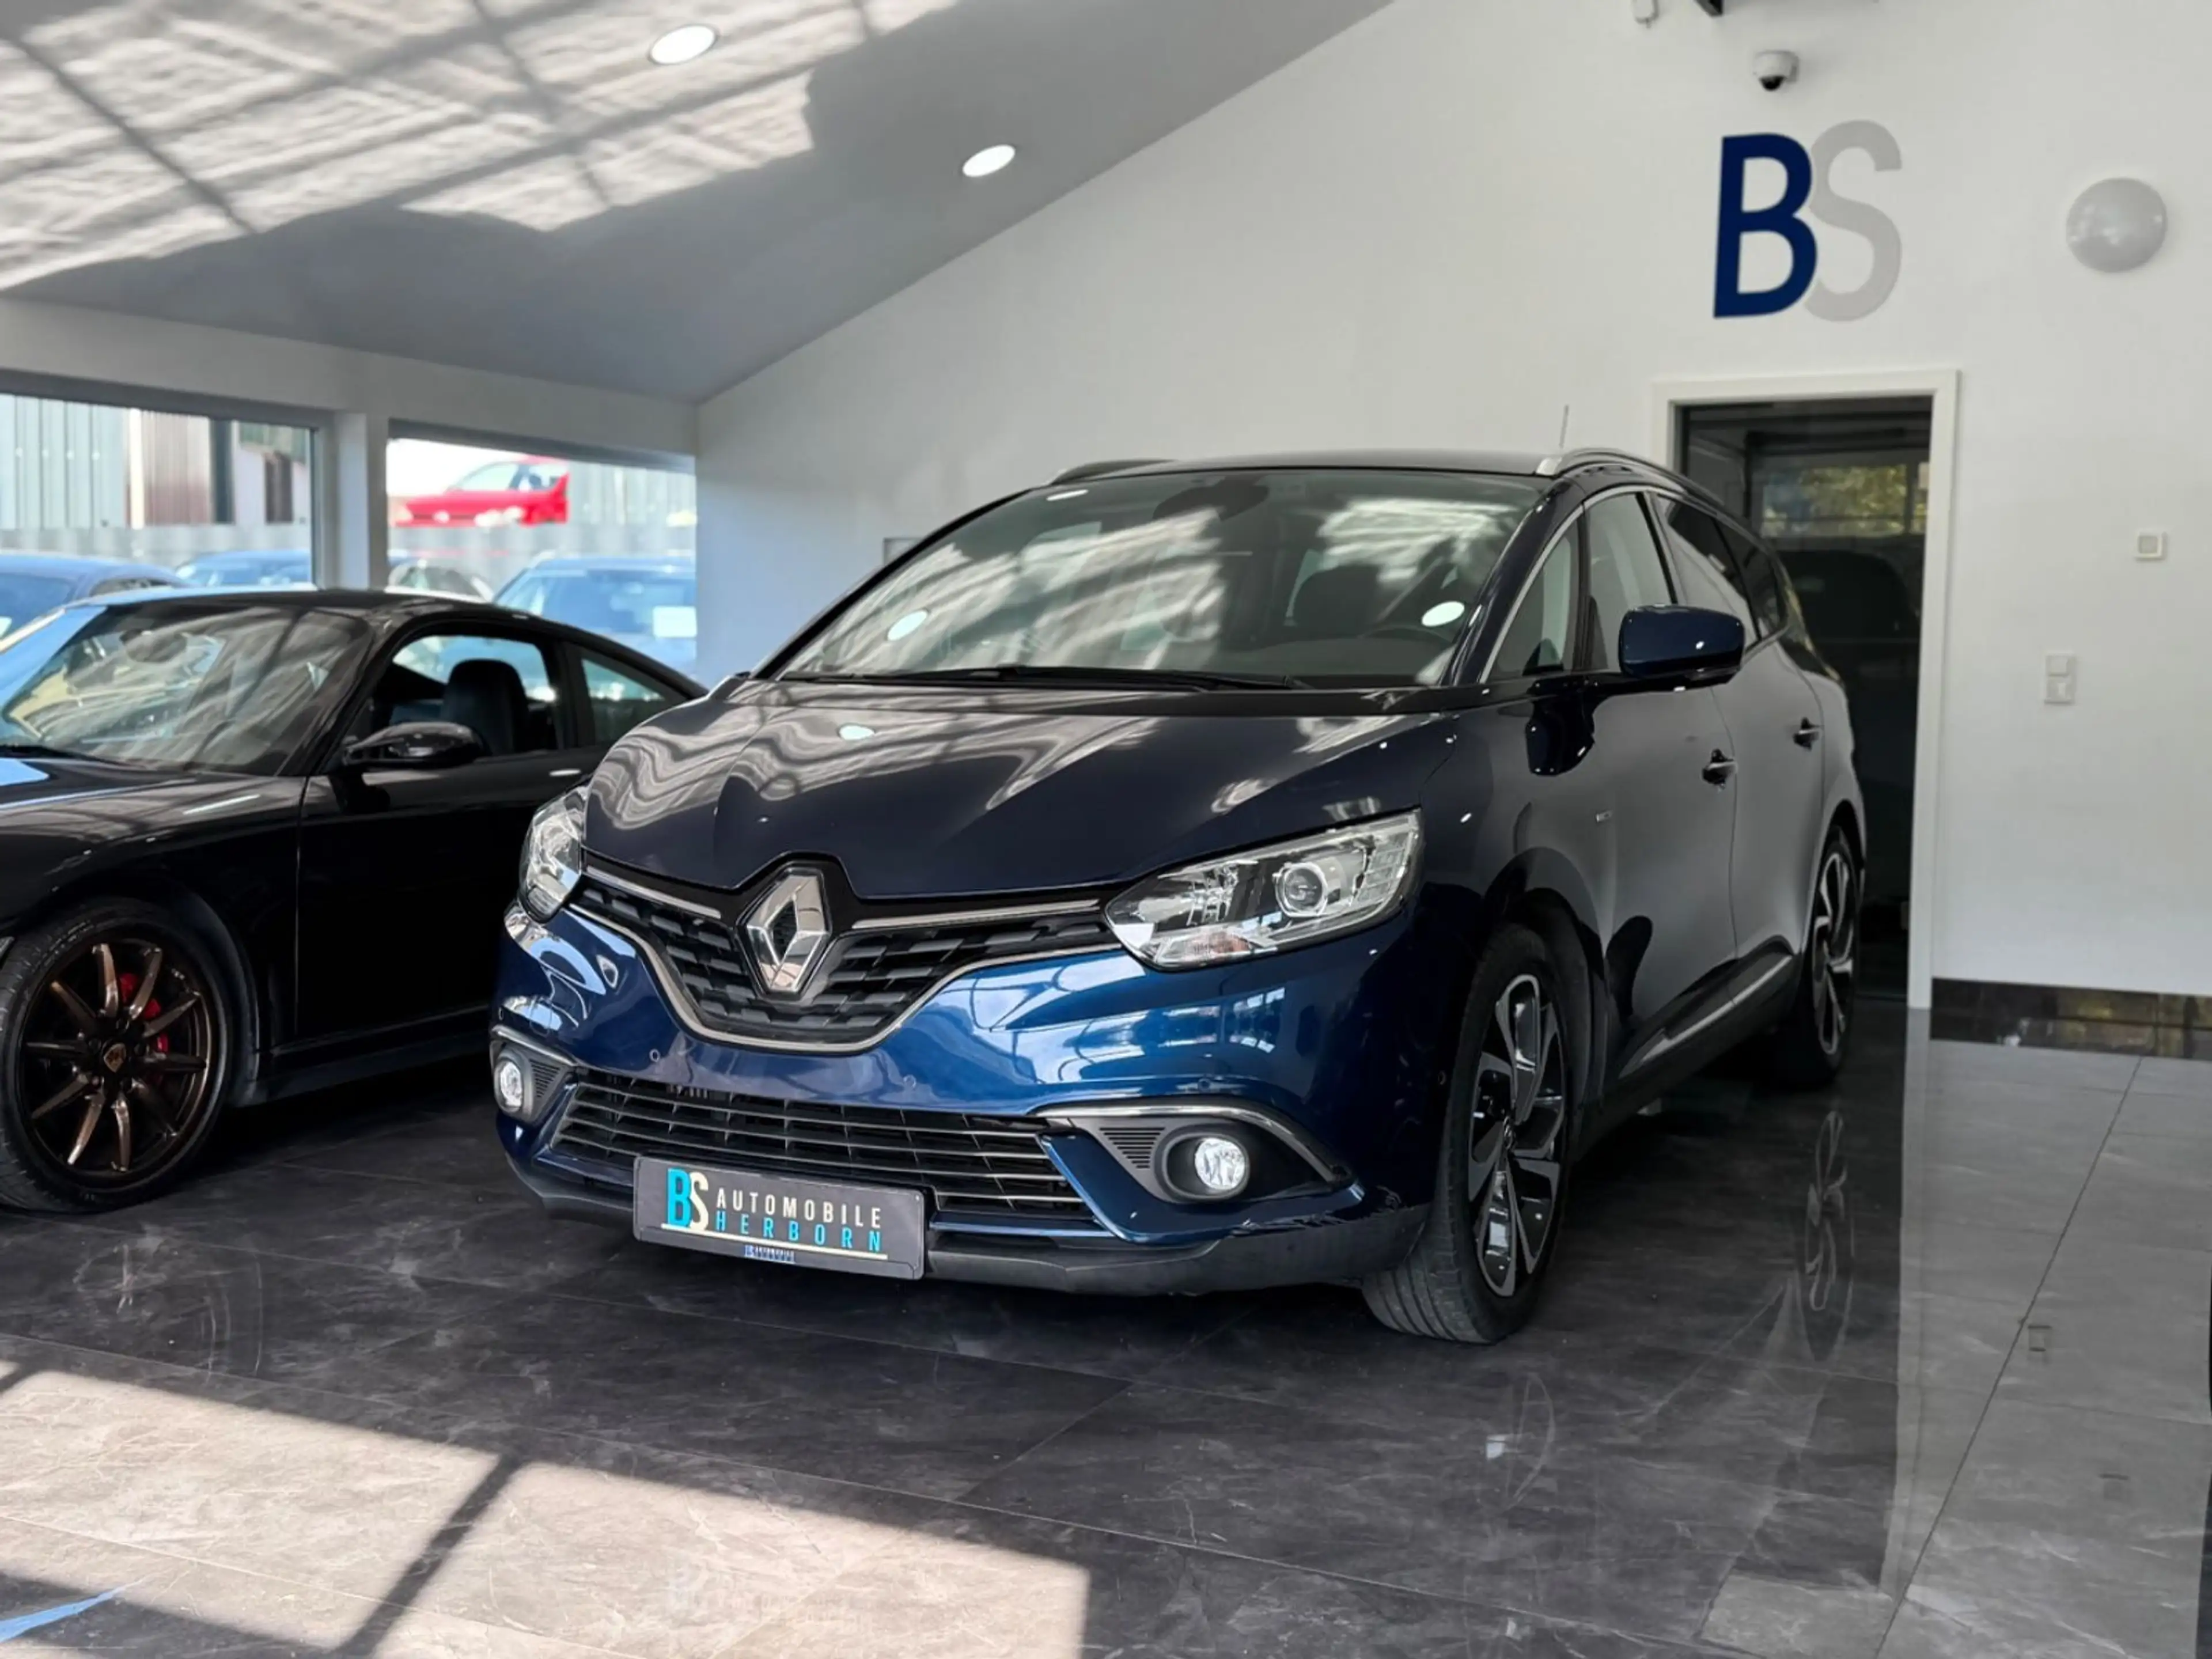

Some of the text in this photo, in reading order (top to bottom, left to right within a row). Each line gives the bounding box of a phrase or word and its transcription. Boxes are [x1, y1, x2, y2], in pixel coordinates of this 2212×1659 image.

[1713, 120, 1902, 322] BS
[667, 1168, 881, 1230] BS AUTOMOBILE
[716, 1212, 881, 1252] HERBORN
